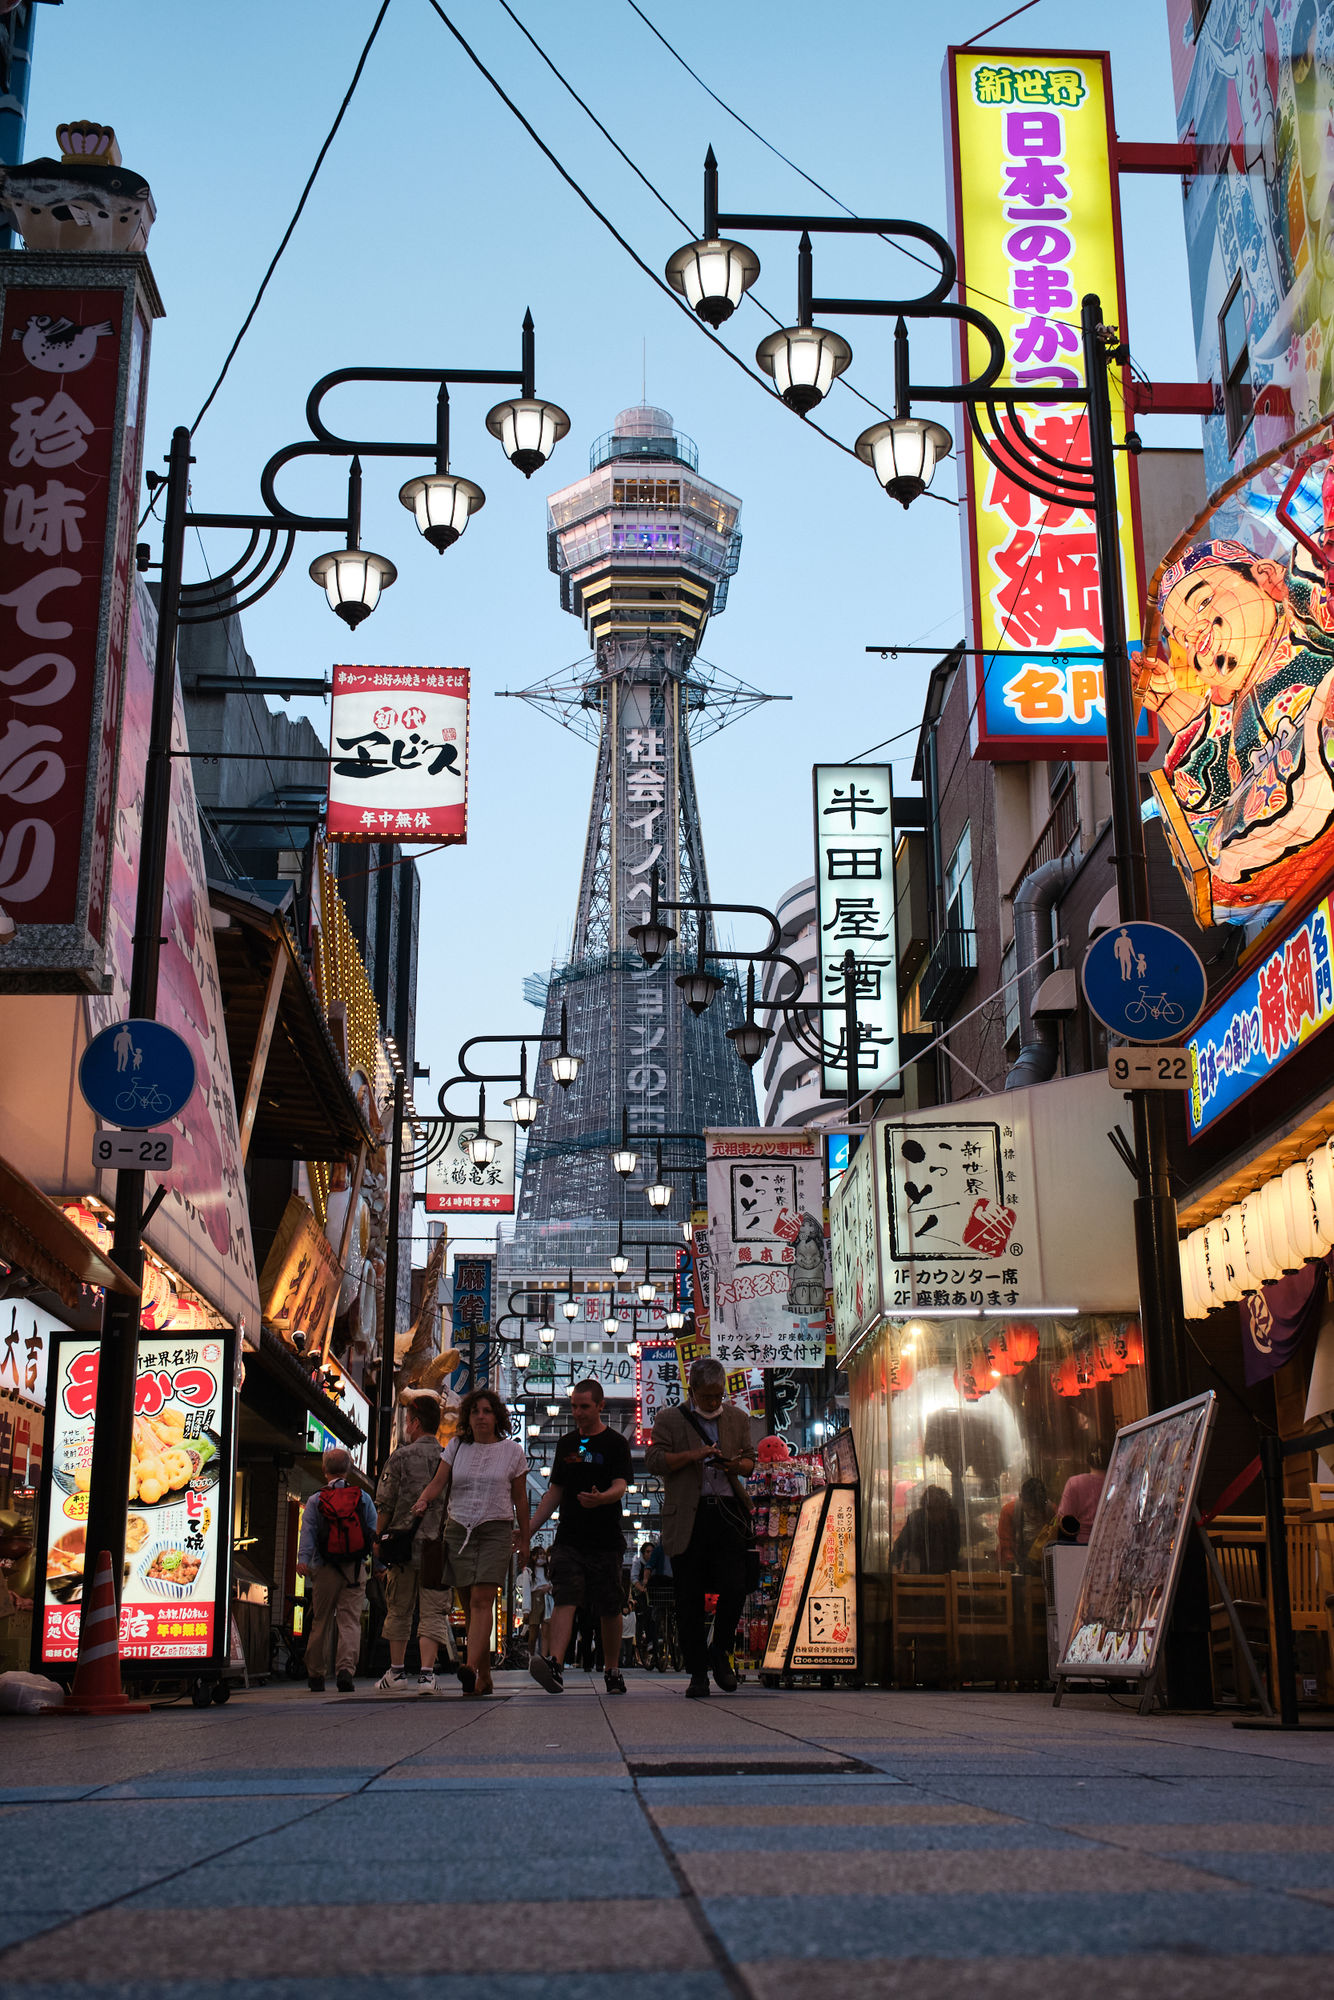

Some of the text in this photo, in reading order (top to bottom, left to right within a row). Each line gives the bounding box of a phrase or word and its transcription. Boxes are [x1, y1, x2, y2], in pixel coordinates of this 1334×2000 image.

[974, 66, 1087, 107] 新世界
[1003, 111, 1080, 410] 日本一の串かつ
[982, 414, 1105, 650] 横綱
[337, 671, 466, 688] 串かつ・お好み焼き・焼きそば
[373, 706, 427, 730] 初代
[359, 811, 432, 829] 年中無休
[823, 783, 894, 1070] 半田屋酒店
[625, 728, 668, 1190] 社会イノベションの日立
[1311, 915, 1334, 1016] 名門
[1258, 927, 1316, 1060] 横綱
[712, 1141, 816, 1156] 元祖串カツ専門店
[960, 1140, 988, 1197] 新世界
[1002, 1125, 1019, 1205] 商標登録
[438, 1196, 501, 1208] 24時間営業中
[455, 1262, 487, 1322] 麻雀
[894, 1268, 1019, 1285] 1F カウンター席
[893, 1289, 1020, 1306] 2F 座敷あります
[0, 1305, 44, 1394] 大吉
[652, 1350, 676, 1359] Asahi
[716, 1344, 823, 1361] 宴会予約受付中
[184, 1491, 207, 1551] どて焼
[130, 1609, 155, 1638] 吉
[157, 1622, 208, 1638] 年中無休
